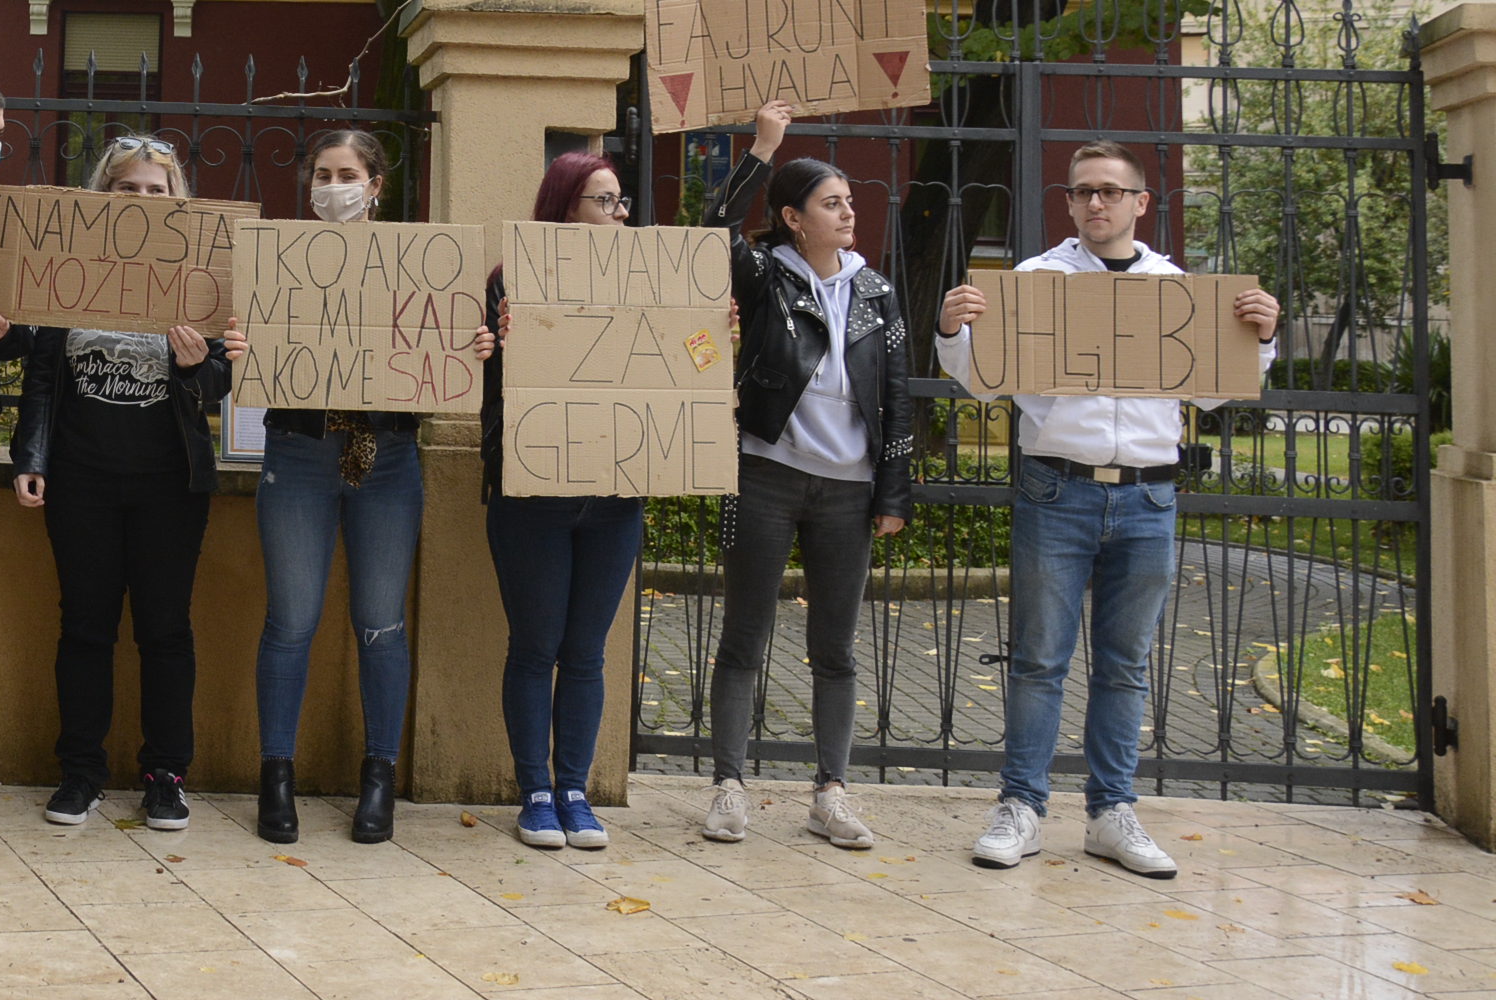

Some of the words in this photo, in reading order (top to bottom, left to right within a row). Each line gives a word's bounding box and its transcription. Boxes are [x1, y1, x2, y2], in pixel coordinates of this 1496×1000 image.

[718, 53, 857, 113] HVALA
[155, 200, 234, 271] ŠTA
[239, 226, 348, 289] TKO
[360, 230, 463, 292] AKO
[513, 222, 732, 306] NEMAMO
[18, 253, 220, 323] MOŽEMO
[390, 288, 486, 351] KAD
[235, 344, 320, 406] AKO
[325, 347, 374, 406] NE
[386, 349, 474, 405] SAD
[563, 312, 678, 387] ZA
[99, 374, 170, 402] Morning
[513, 400, 728, 494] GERME
